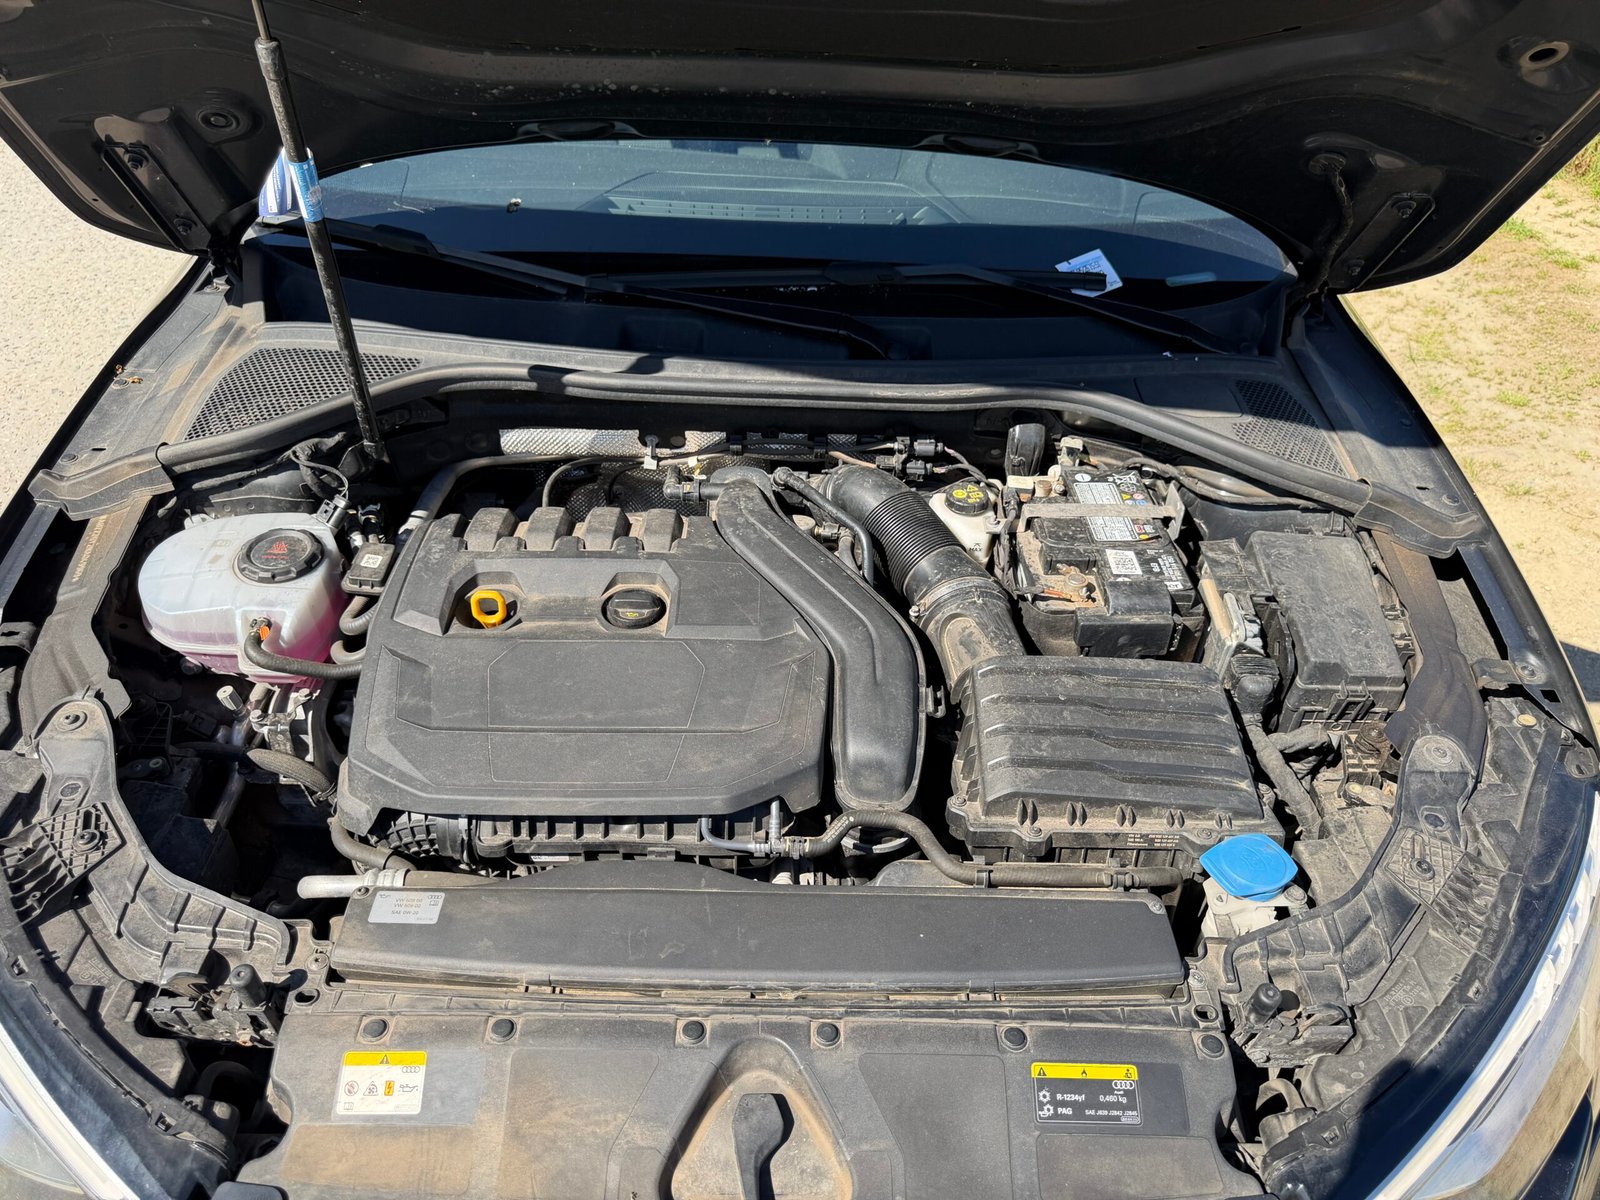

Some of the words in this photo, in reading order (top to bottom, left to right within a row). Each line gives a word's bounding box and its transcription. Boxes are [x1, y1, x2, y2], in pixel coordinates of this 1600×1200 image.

[1056, 1093, 1085, 1102] R-1234yf
[1118, 1095, 1127, 1103] kg
[1057, 1107, 1073, 1115] PAG
